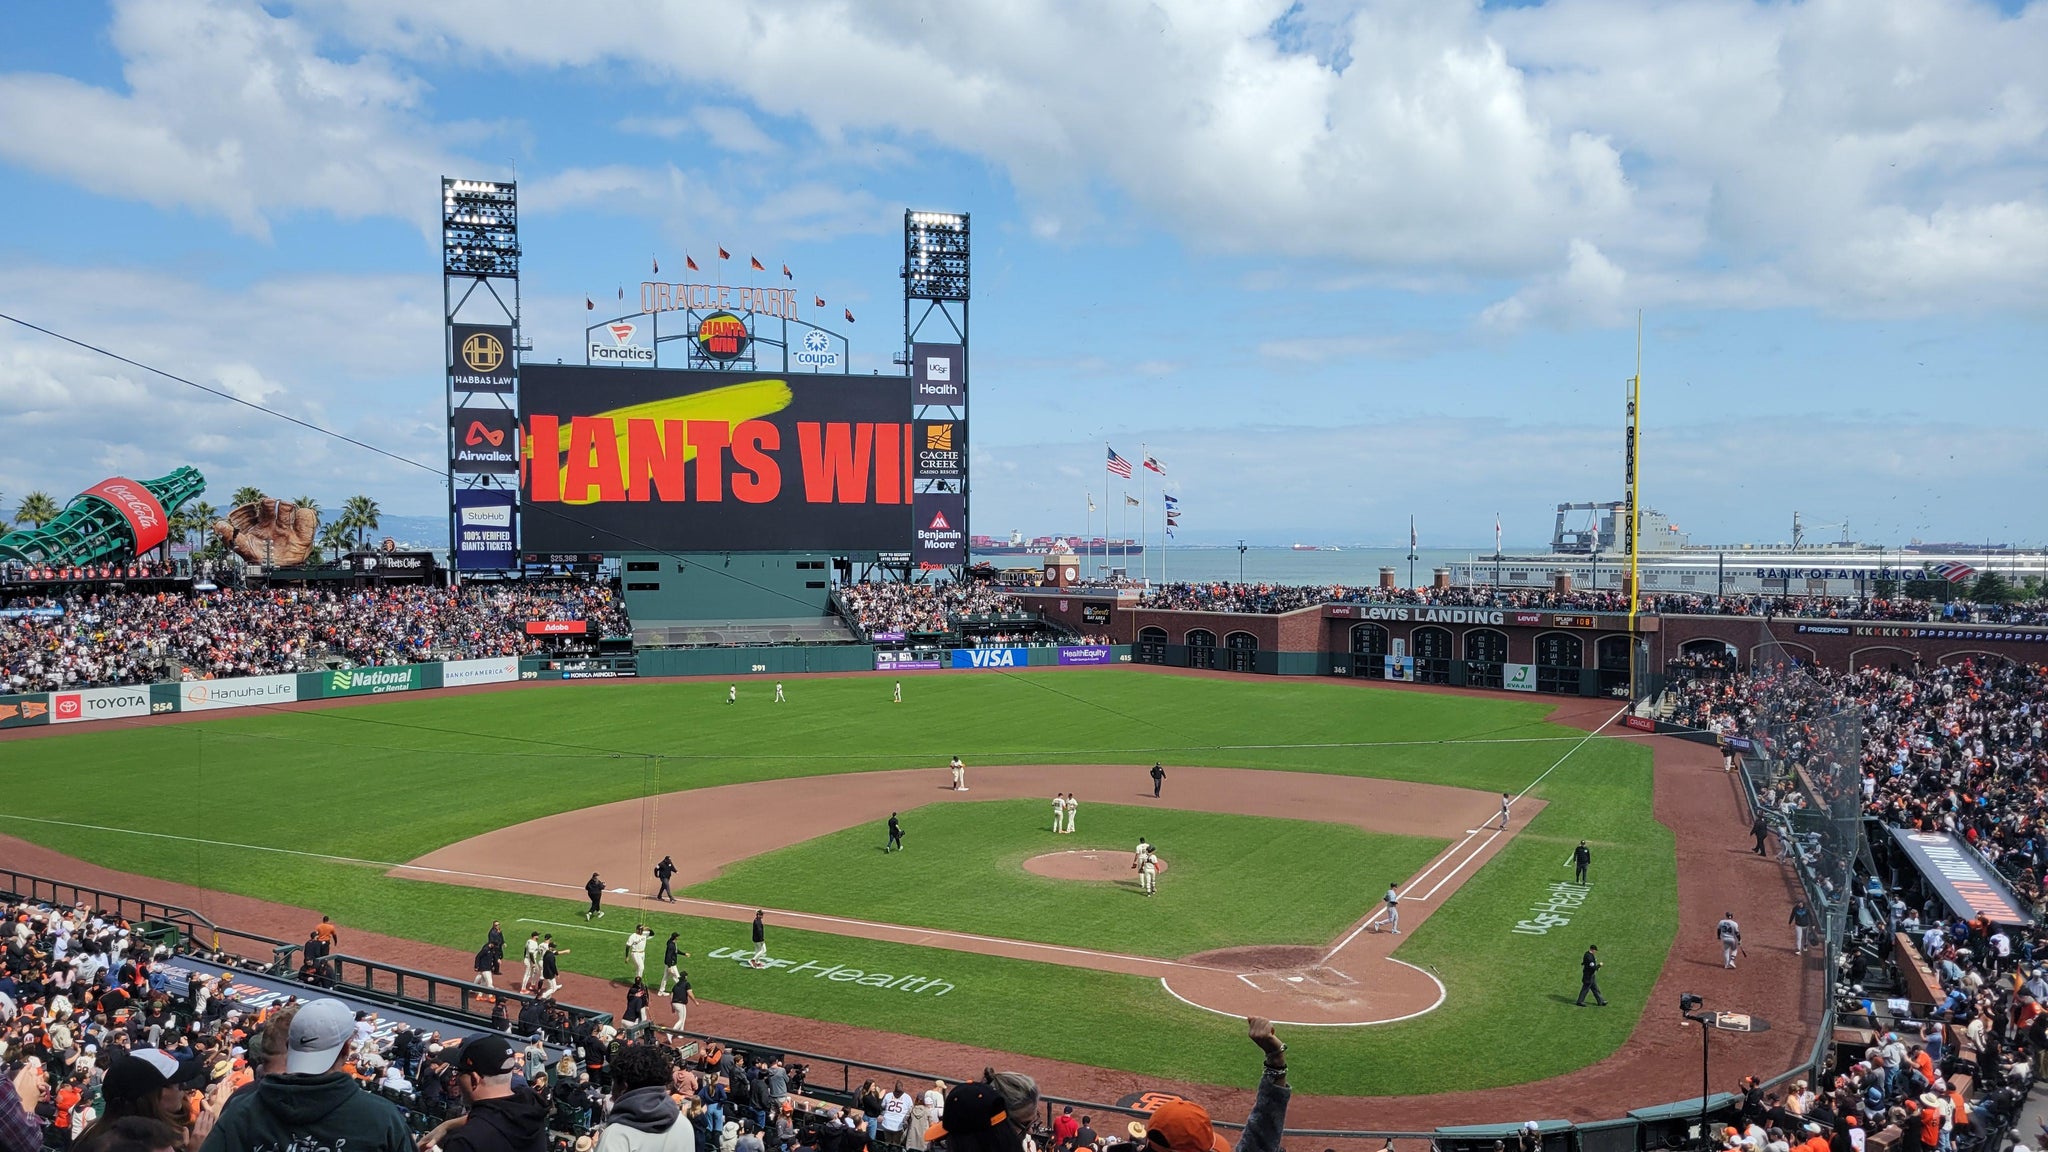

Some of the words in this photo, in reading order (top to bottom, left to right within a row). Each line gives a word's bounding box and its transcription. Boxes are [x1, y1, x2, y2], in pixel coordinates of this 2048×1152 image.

[641, 282, 730, 314] ORACLE
[740, 288, 798, 322] PARK
[700, 322, 746, 338] GIANTS
[709, 338, 738, 353] WIN
[591, 344, 653, 360] Fanatics
[798, 352, 836, 366] coupa
[456, 376, 491, 384] HABBAS
[493, 376, 512, 385] LAW
[920, 384, 958, 394] Health
[458, 450, 512, 462] Airwallex
[520, 414, 782, 504] IANTS
[920, 451, 958, 460] CACHE
[921, 460, 957, 468] CREEK
[102, 484, 159, 531] Coca-Cola
[468, 512, 504, 520] StubHub
[463, 531, 481, 541] 100%
[482, 531, 510, 541] VERIFIED
[918, 530, 960, 541] Benjamin
[462, 542, 485, 551] GIANTS
[486, 542, 512, 551] TICKETS
[924, 540, 955, 549] Moore
[404, 558, 421, 568] Coffee
[1757, 568, 1804, 580] BANK
[1810, 568, 1832, 580] OF
[1838, 568, 1928, 581] AMERICA
[1415, 609, 1504, 625] LANDING
[966, 650, 1014, 667] VISA
[1063, 650, 1106, 658] HealthEquity
[474, 668, 503, 677] AMERICA
[752, 664, 766, 672] 391
[352, 668, 411, 688] National
[211, 686, 264, 700] Hanwha
[267, 684, 291, 696] Life
[372, 685, 386, 693] Car
[387, 683, 410, 692] Rental
[1612, 688, 1630, 696] 309
[88, 696, 145, 710] TOYOTA
[152, 702, 173, 712] 354
[1630, 719, 1650, 728] ORACLE
[786, 960, 955, 996] Health
[888, 1101, 903, 1113] 25
